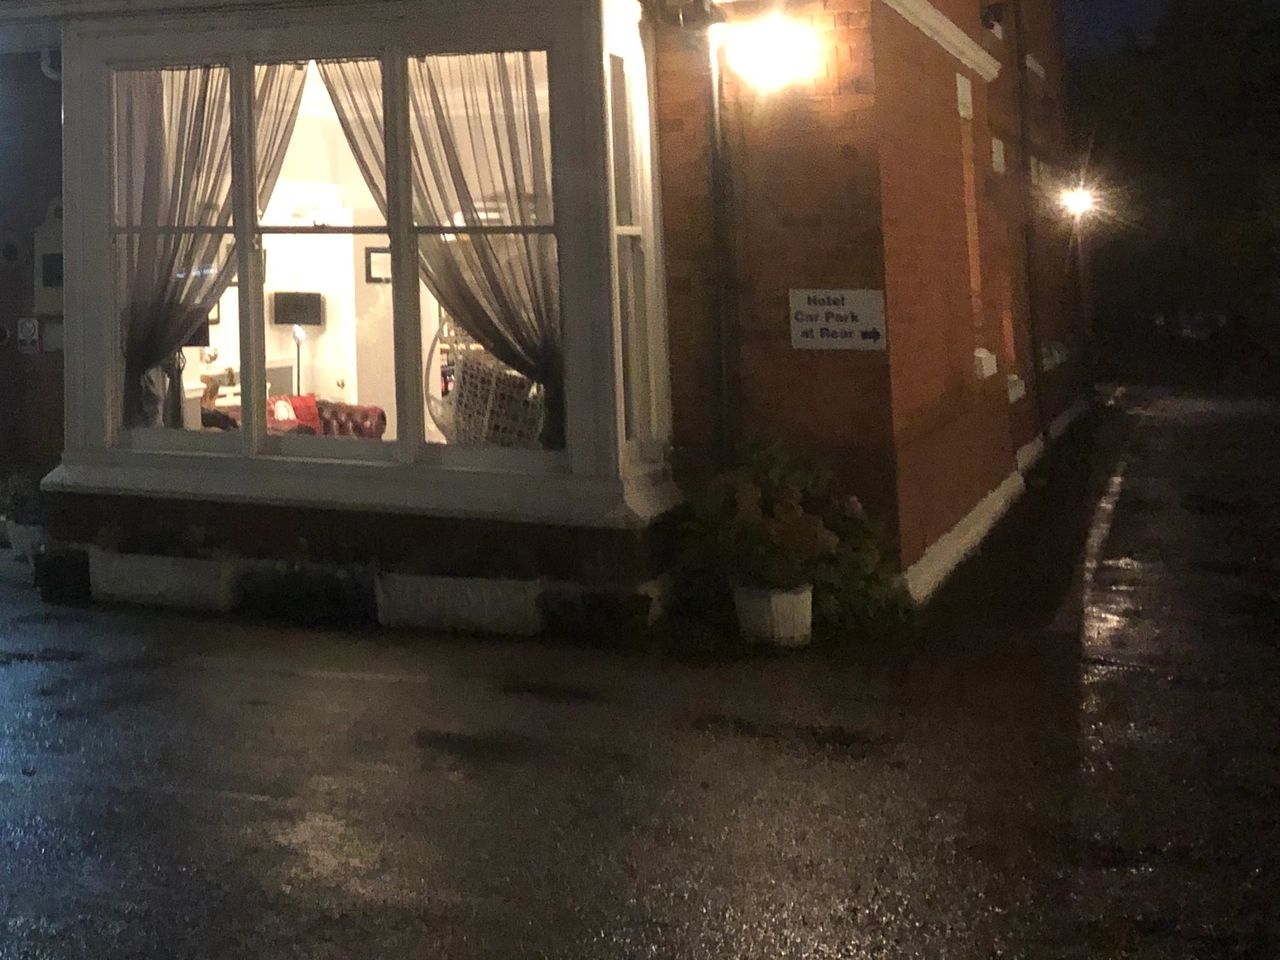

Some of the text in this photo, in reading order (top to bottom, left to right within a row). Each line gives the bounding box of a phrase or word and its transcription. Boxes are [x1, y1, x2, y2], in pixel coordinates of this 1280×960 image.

[807, 295, 845, 306] Hotel
[794, 311, 859, 322] Car Park
[800, 327, 853, 339] at Rear
